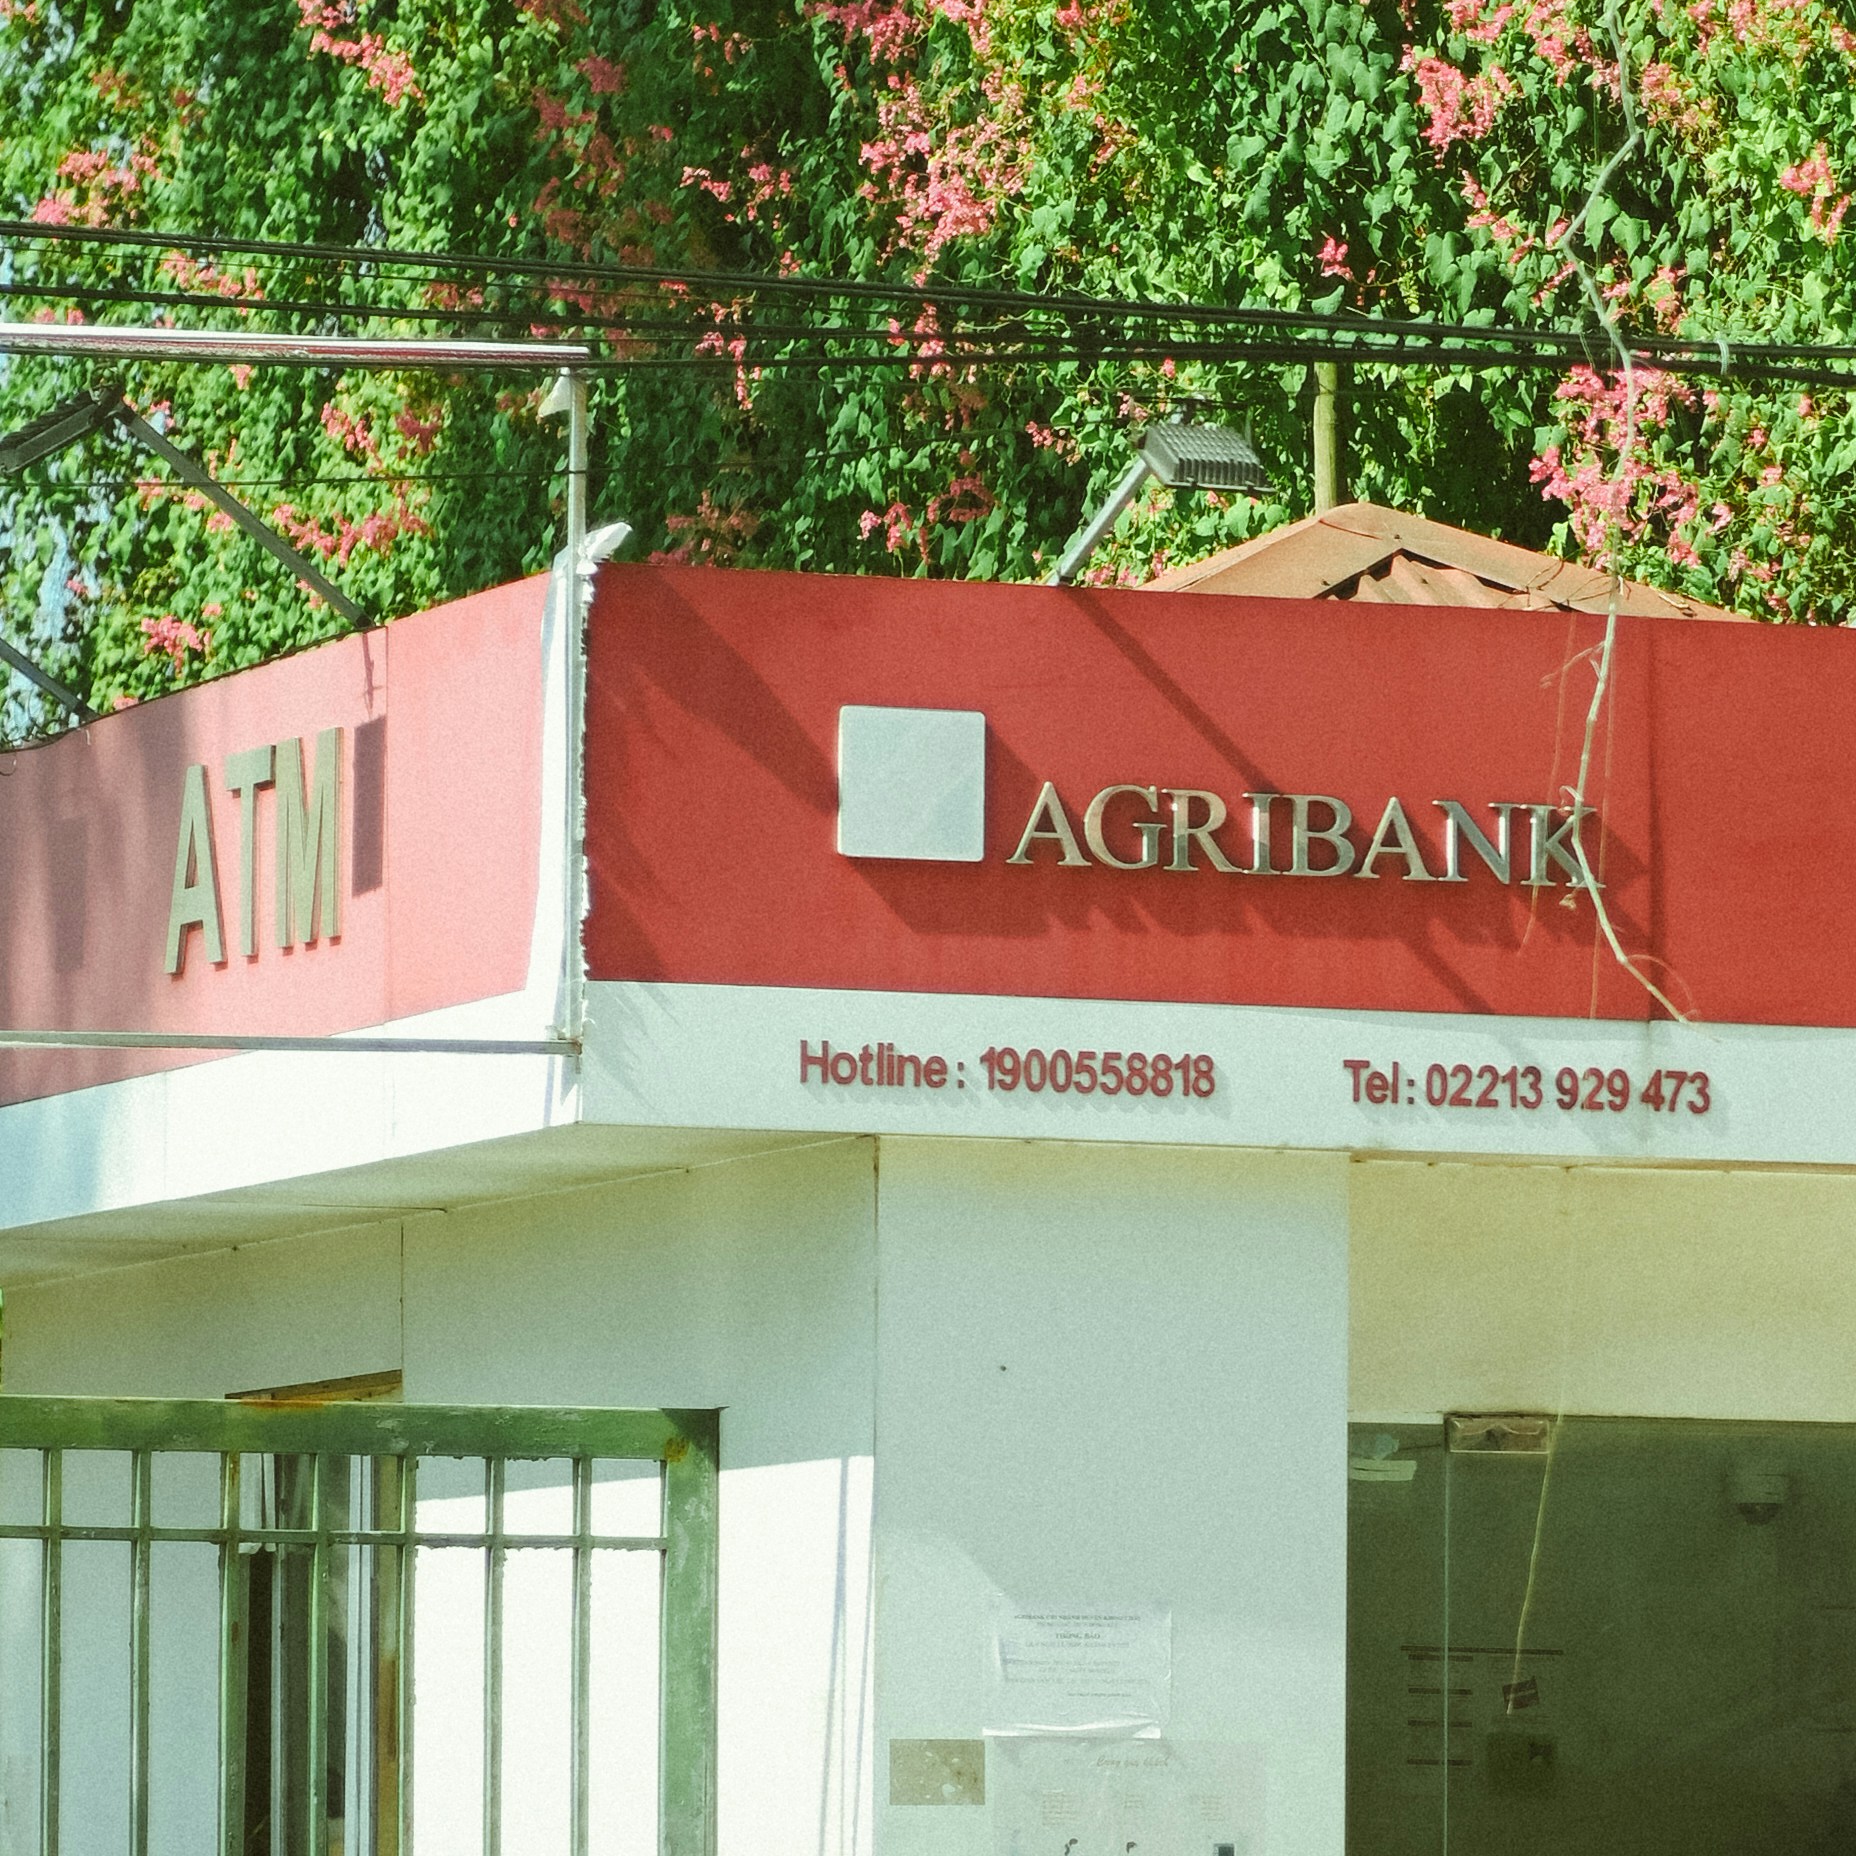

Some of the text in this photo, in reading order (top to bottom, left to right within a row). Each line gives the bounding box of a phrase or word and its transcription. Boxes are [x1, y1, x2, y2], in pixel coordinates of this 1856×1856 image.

[164, 726, 344, 975] ATM
[1005, 781, 1606, 888] AGRIBANK
[979, 1046, 1216, 1098] 1900558818
[1343, 1059, 1711, 1115] Tel: 02213 929 473
